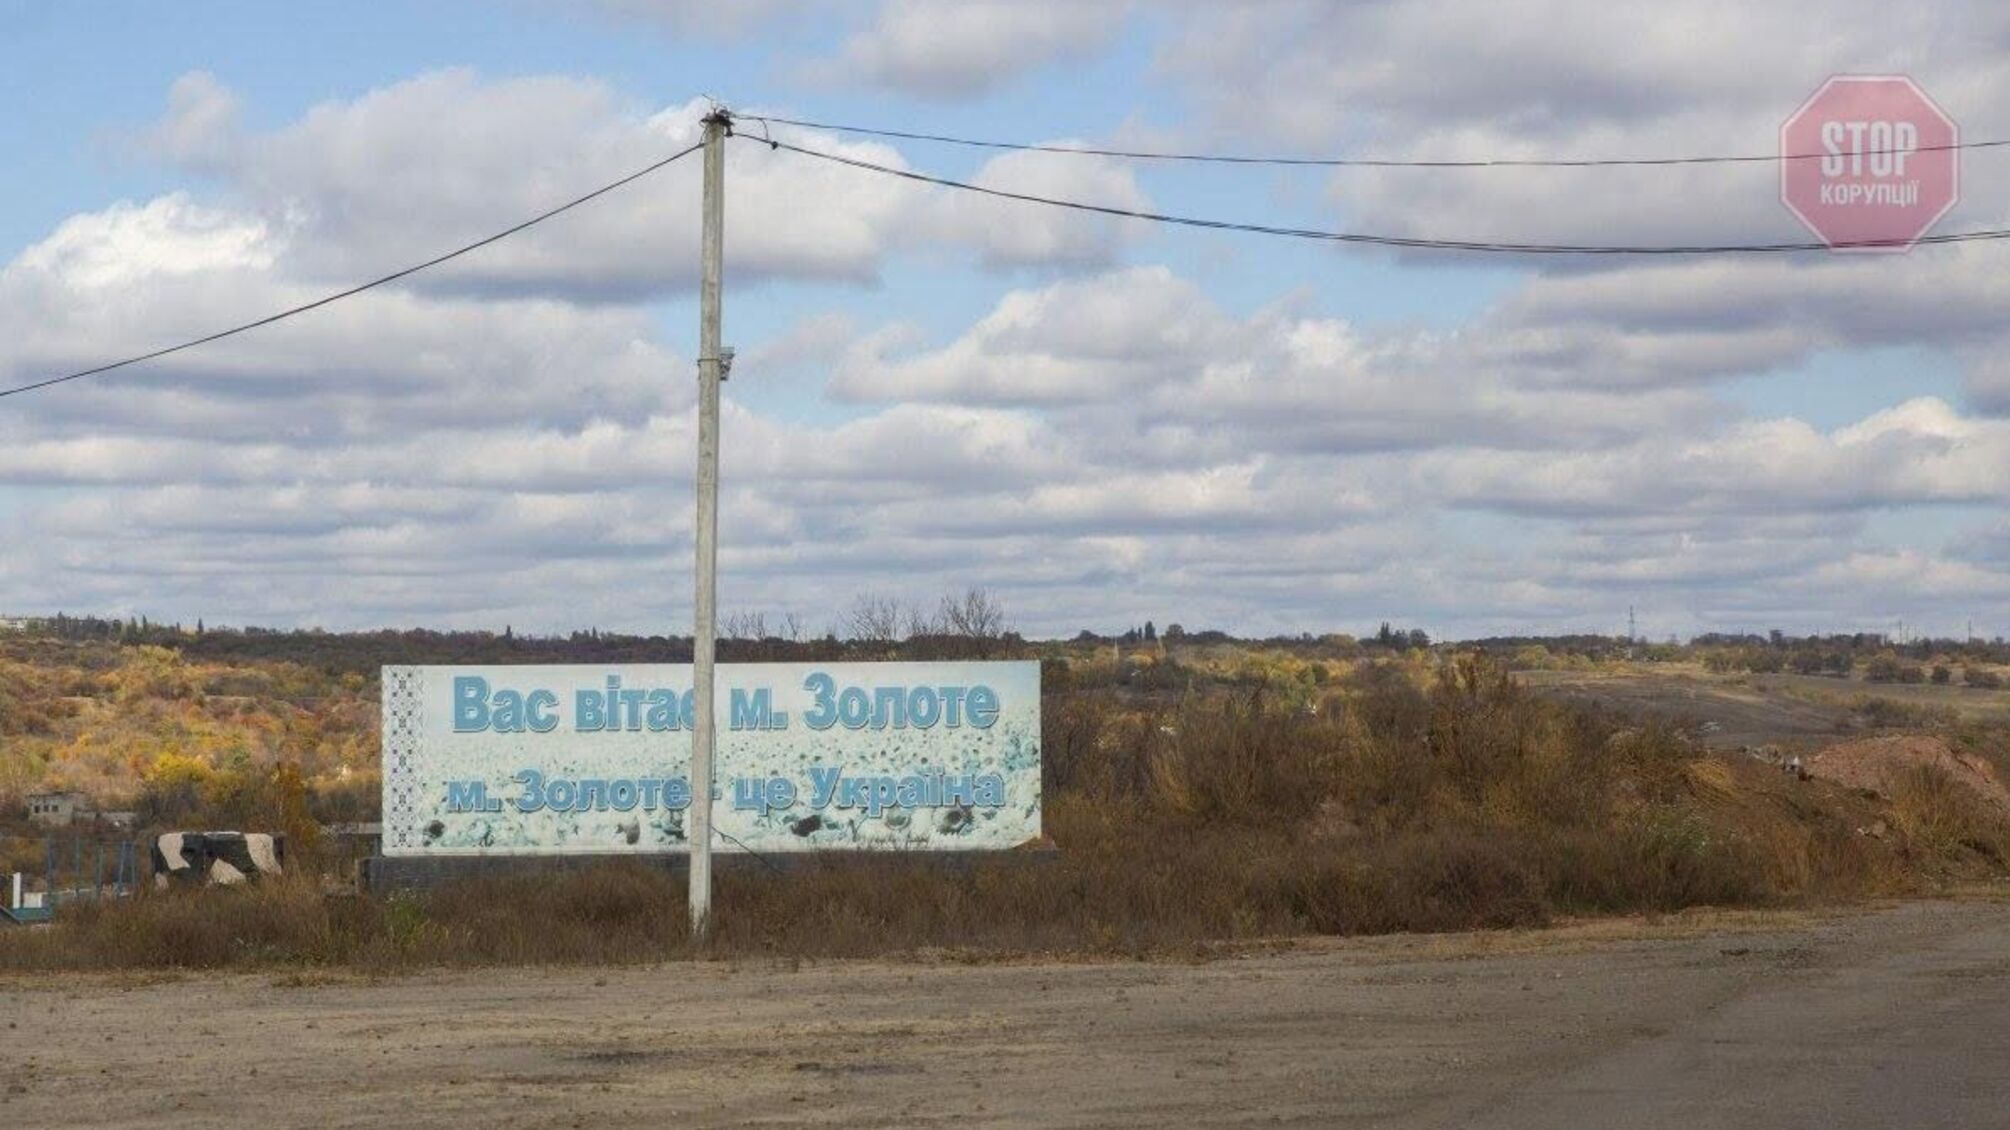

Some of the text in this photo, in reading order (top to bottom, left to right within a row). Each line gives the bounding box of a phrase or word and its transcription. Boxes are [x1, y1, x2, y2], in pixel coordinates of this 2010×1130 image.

[453, 675, 560, 732] Вас
[729, 687, 788, 731] м.
[803, 671, 1000, 731] Золоте
[449, 765, 1005, 819] м. Золоте це Україна
